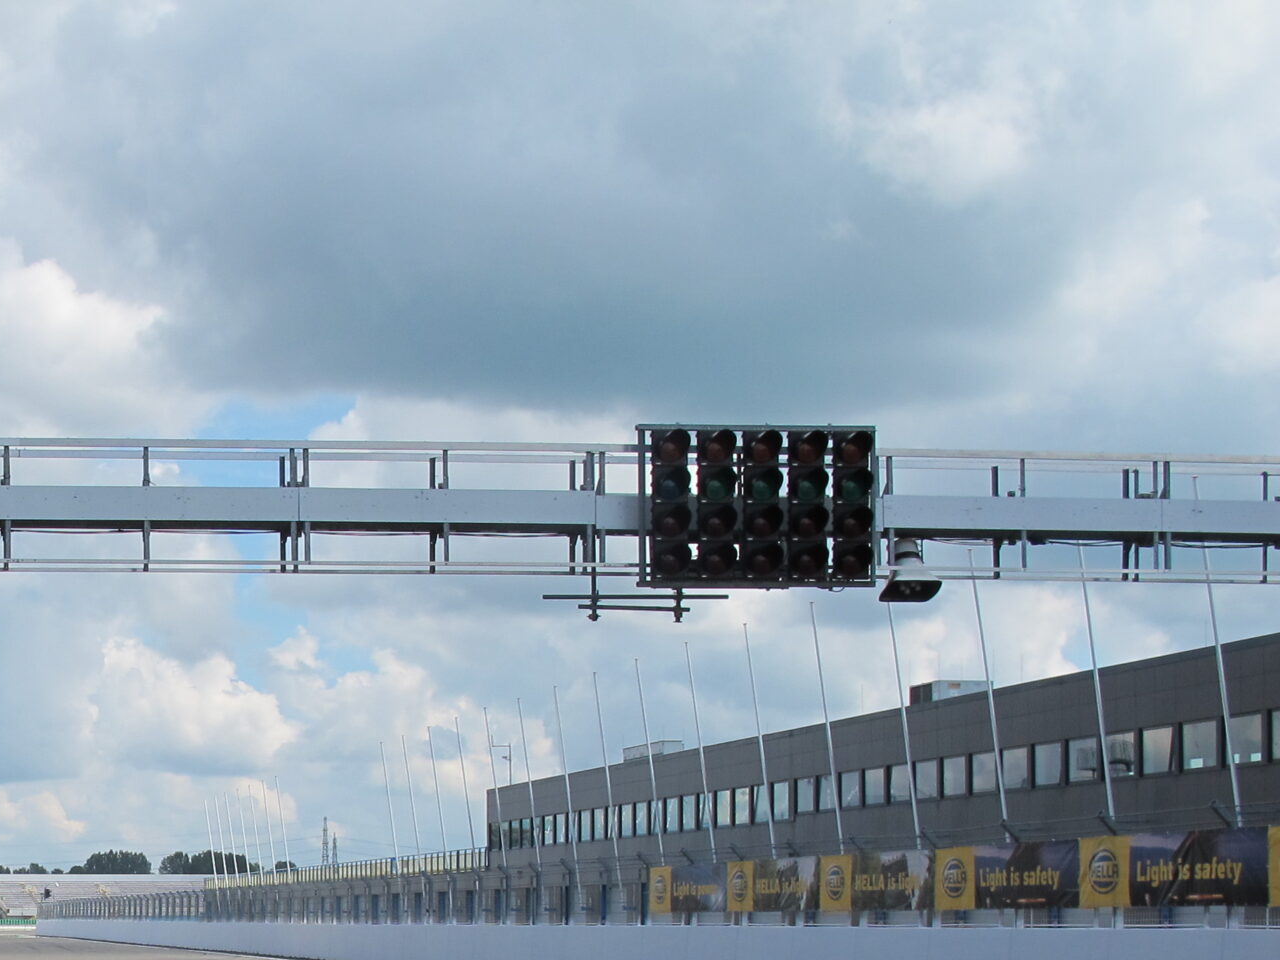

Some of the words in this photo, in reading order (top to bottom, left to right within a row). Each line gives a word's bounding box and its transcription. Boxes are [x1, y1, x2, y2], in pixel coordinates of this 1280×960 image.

[855, 873, 885, 891] HELLA
[888, 872, 896, 890] is
[979, 867, 1007, 892] Light
[1010, 866, 1020, 886] is
[1023, 865, 1061, 890] safety
[1136, 859, 1173, 887] Light
[1178, 858, 1190, 881] is
[1194, 856, 1242, 884] safety
